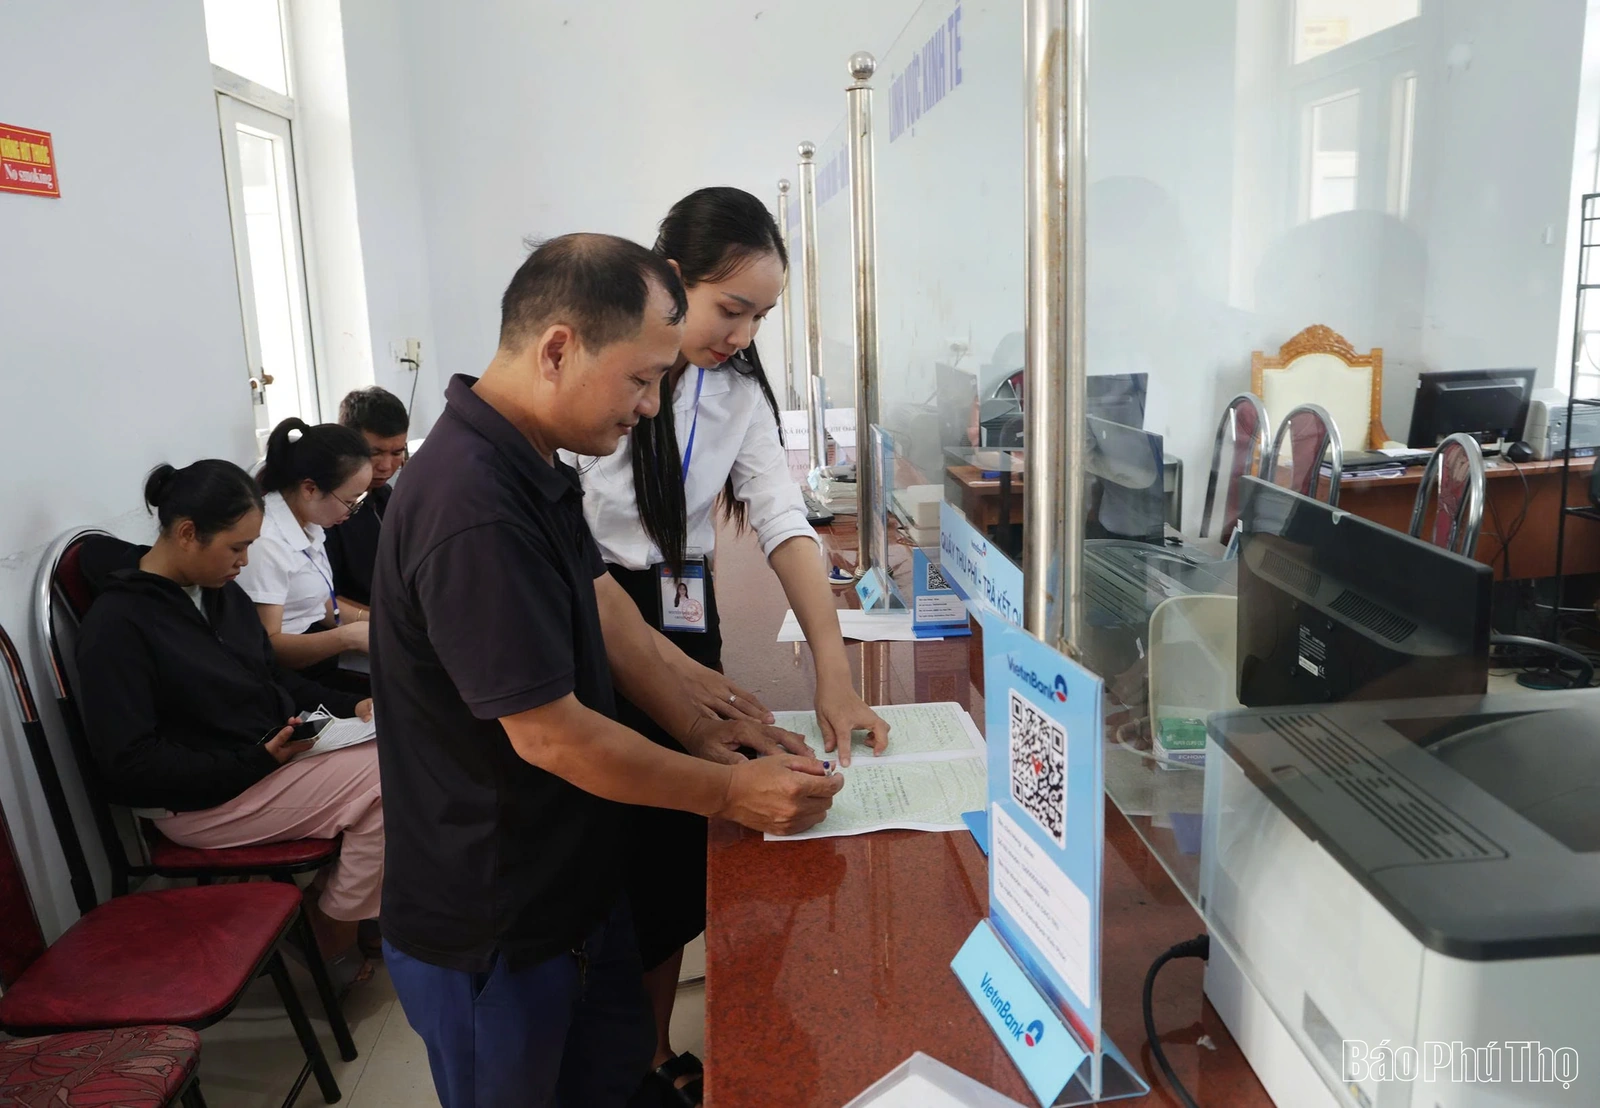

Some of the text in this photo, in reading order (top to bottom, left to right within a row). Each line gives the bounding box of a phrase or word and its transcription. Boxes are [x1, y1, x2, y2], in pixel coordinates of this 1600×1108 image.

[4, 163, 53, 189] No smoking
[1007, 653, 1056, 703] VietinBank
[980, 971, 1025, 1042] VietinBank
